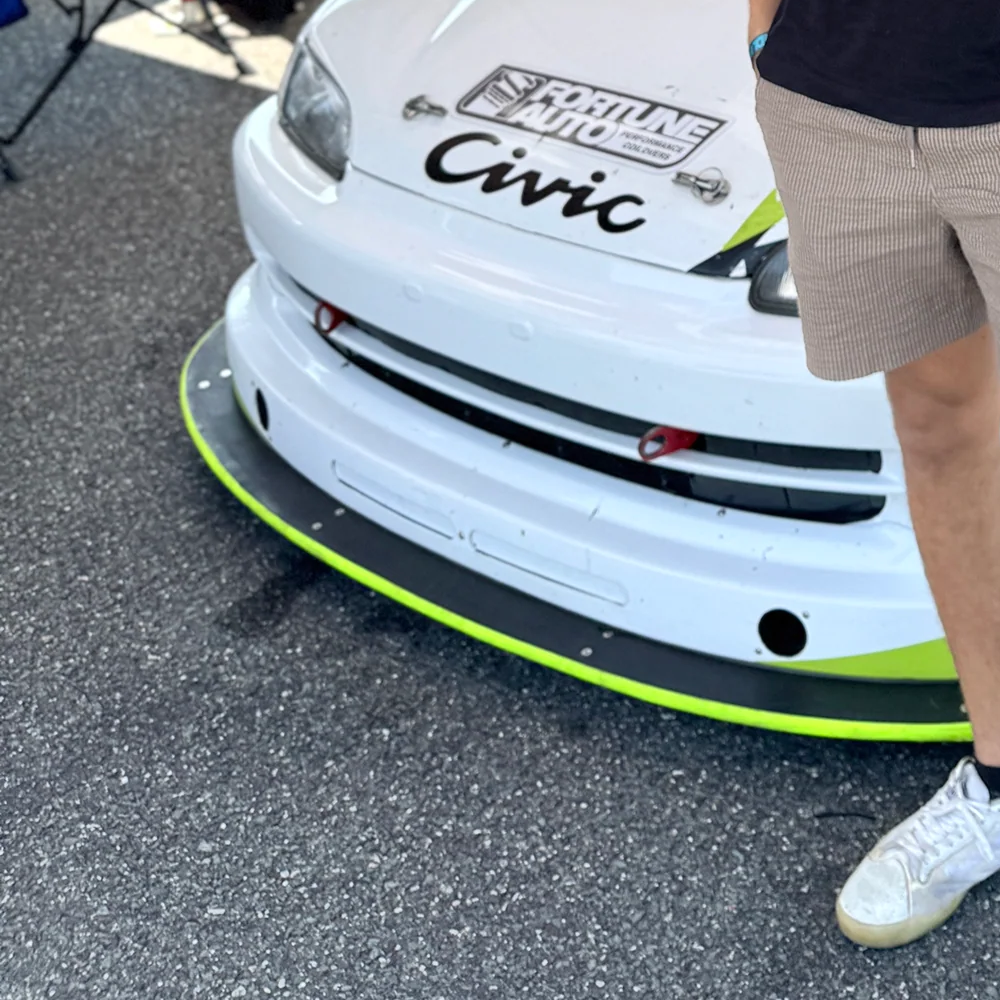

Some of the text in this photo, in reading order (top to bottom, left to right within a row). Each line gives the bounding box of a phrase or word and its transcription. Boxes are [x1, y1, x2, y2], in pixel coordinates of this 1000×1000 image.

[508, 101, 618, 148] AUTO
[534, 79, 718, 141] FORTUNE
[424, 131, 646, 234] Civic
